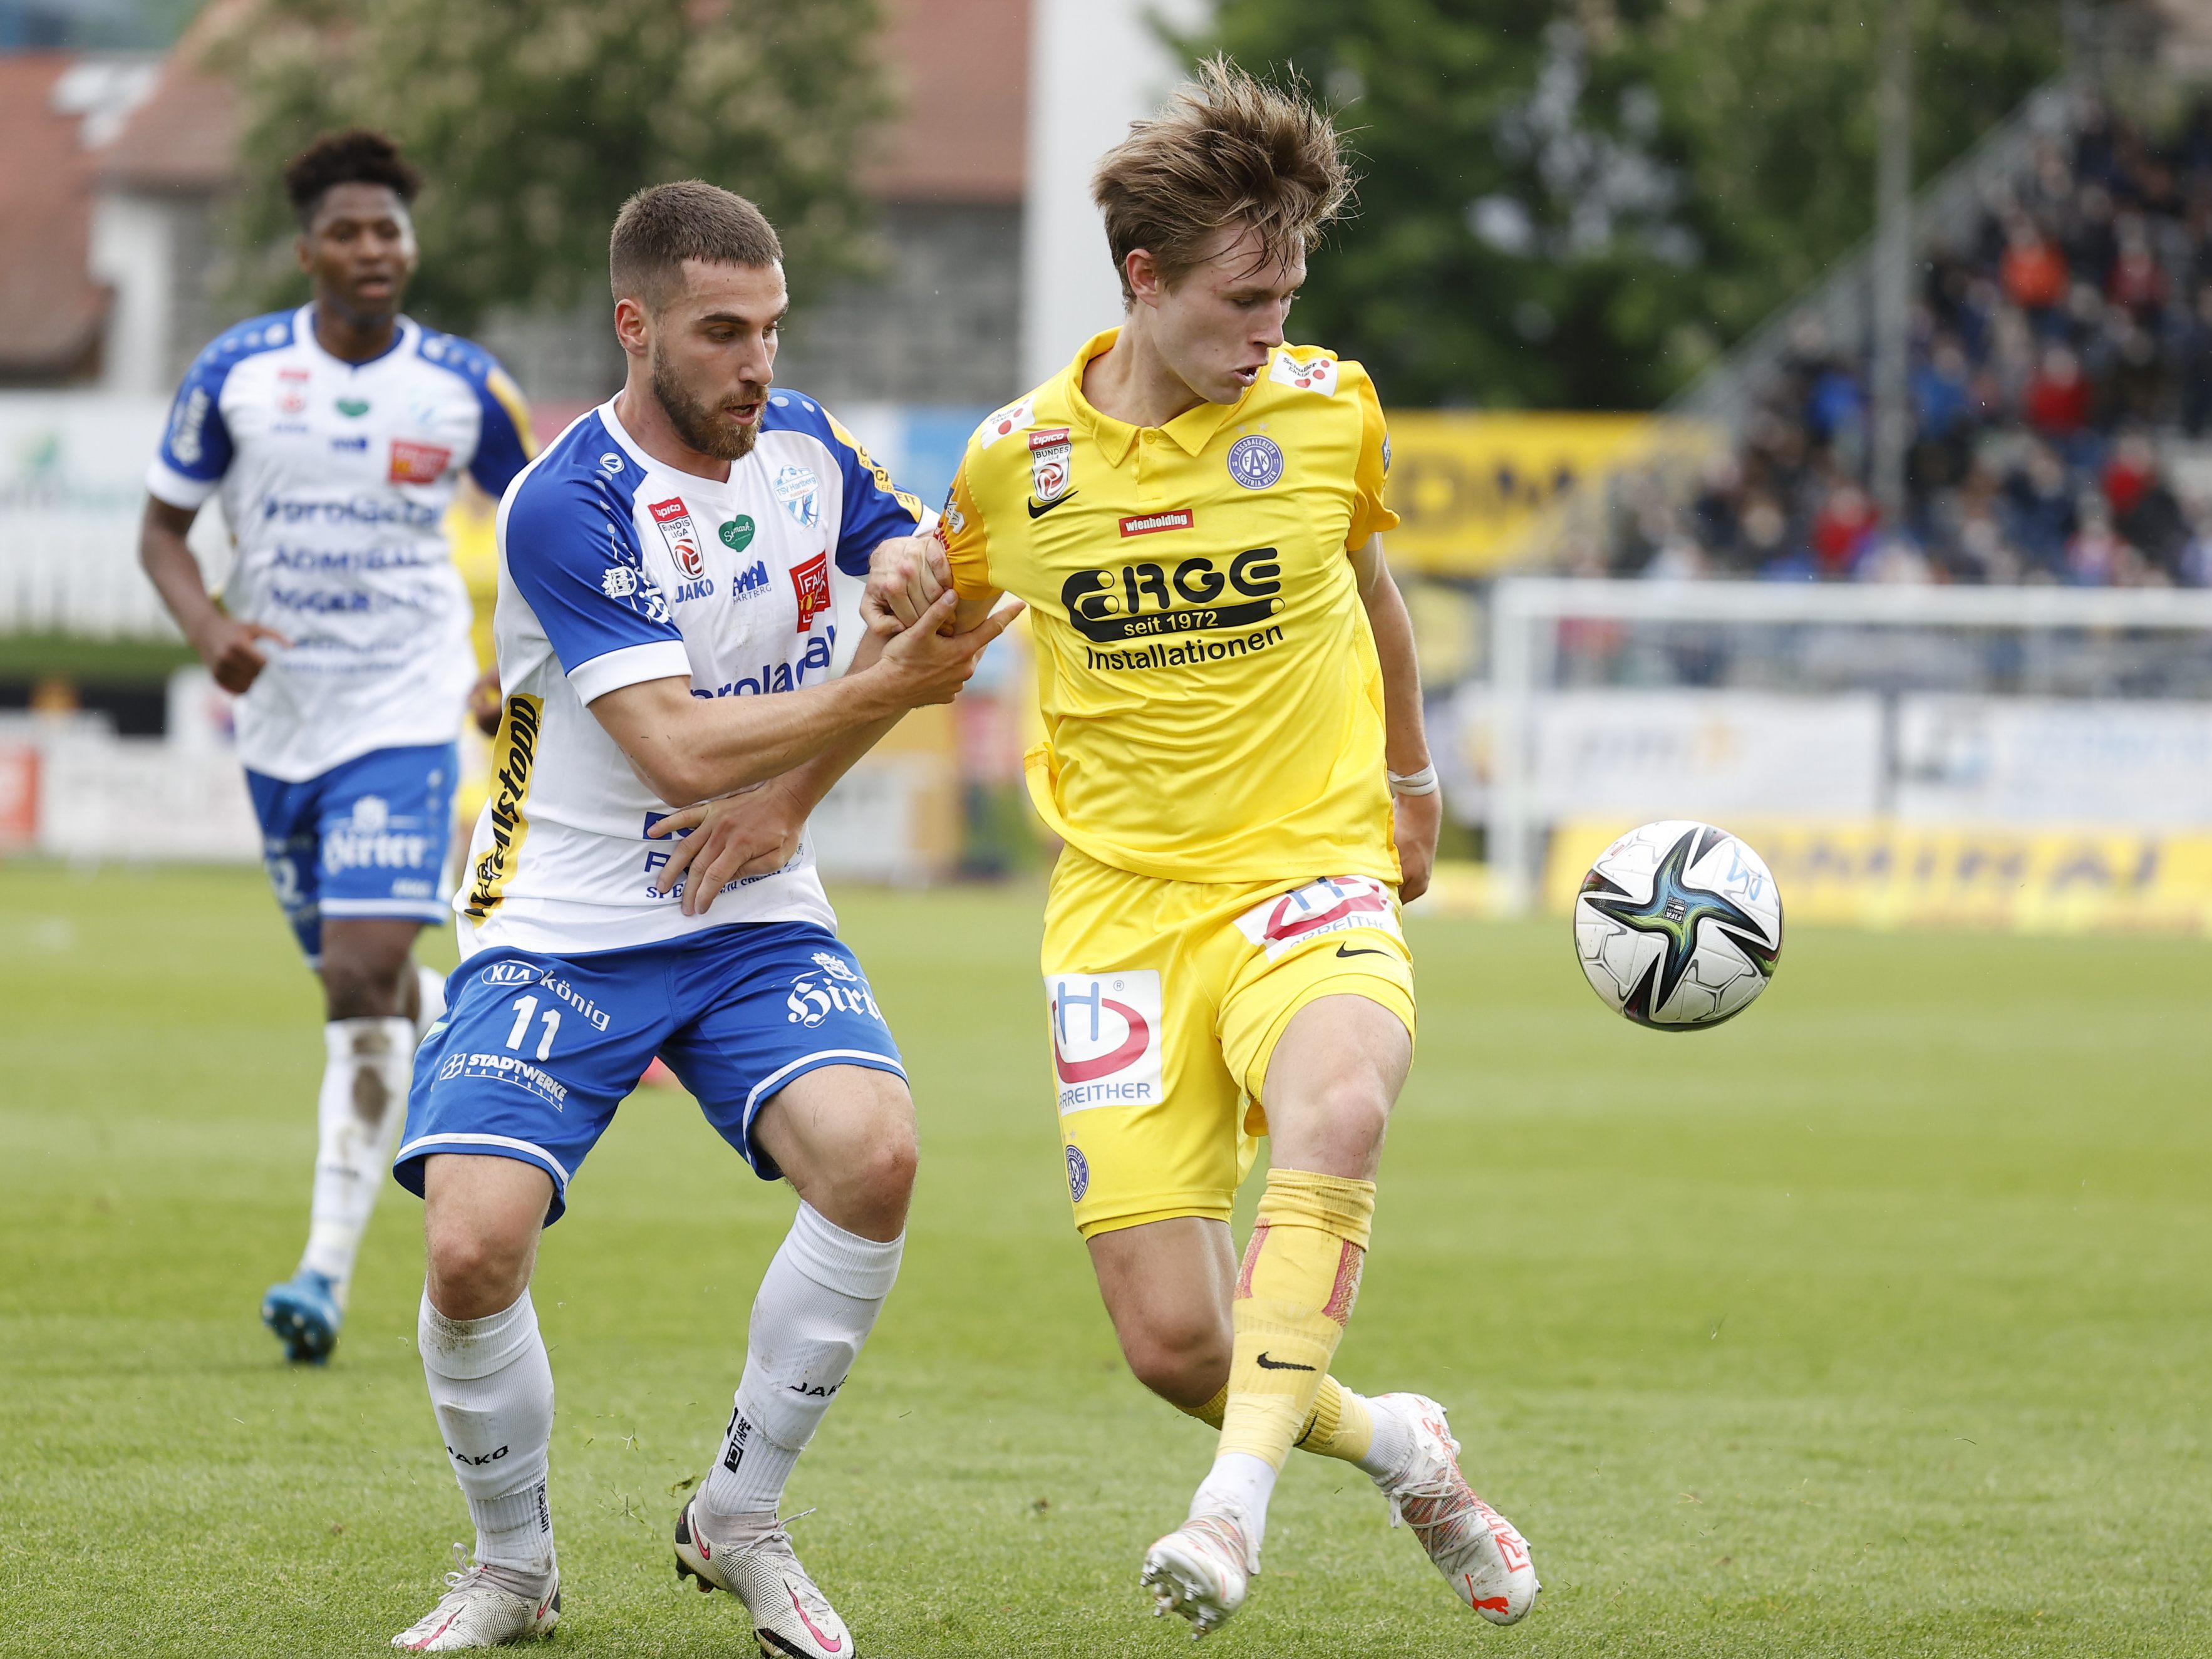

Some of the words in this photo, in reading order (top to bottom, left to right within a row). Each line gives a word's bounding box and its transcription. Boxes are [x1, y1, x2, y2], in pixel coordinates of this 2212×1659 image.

[1033, 433, 1065, 445] tipico
[1234, 438, 1276, 455] FUSSBALLKLUB
[1036, 446, 1069, 458] BUNDES
[1236, 472, 1262, 487] AUSTRIA
[1262, 470, 1277, 485] WIEN
[671, 528, 689, 539] LIGA
[675, 579, 715, 604] JAKO
[1124, 617, 1163, 636] seit
[1167, 611, 1219, 631] 1972
[1085, 625, 1284, 670] Installationen
[1666, 911, 1682, 921] FIFA
[490, 965, 531, 983] KIA
[539, 969, 611, 1032] könig
[505, 995, 561, 1062] 11
[467, 1053, 568, 1102] STADTWERKE
[1059, 1083, 1152, 1110] RREITHER
[733, 1417, 753, 1447] TAPE
